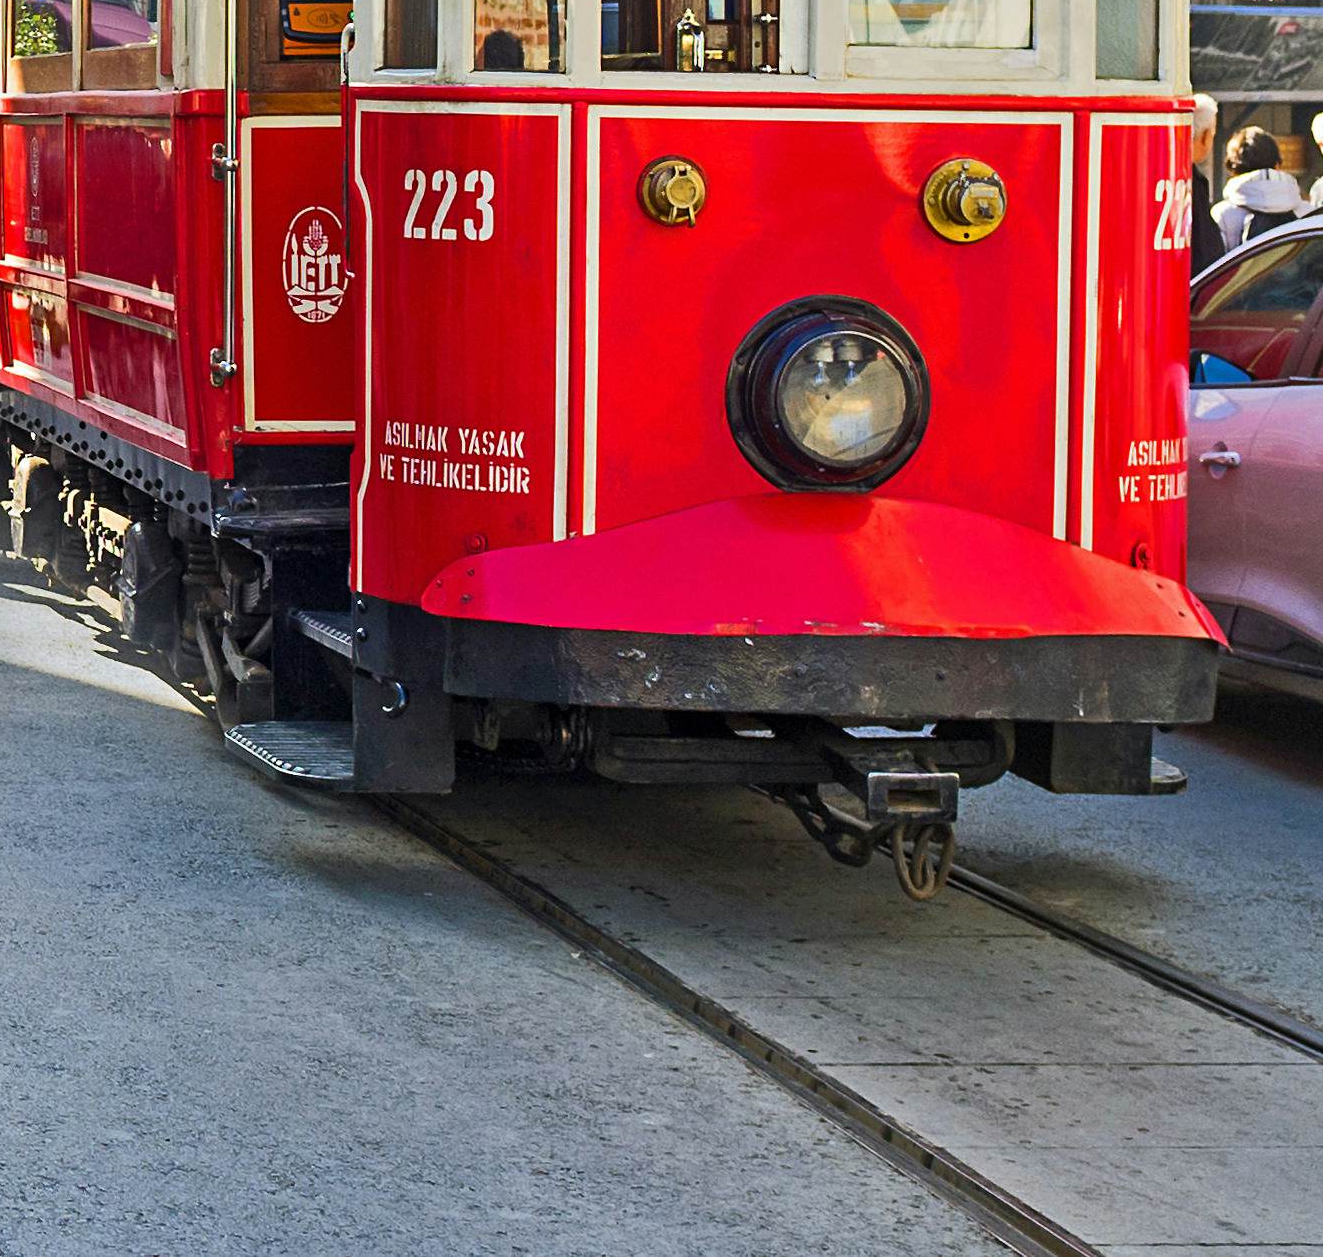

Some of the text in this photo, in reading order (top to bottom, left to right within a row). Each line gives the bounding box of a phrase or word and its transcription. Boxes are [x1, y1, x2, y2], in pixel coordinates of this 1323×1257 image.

[403, 169, 495, 241] 223
[385, 420, 525, 459] ASILMAK YASAK
[379, 453, 530, 494] VE TEHLİKELİDİR
[1118, 475, 1141, 503] VE
